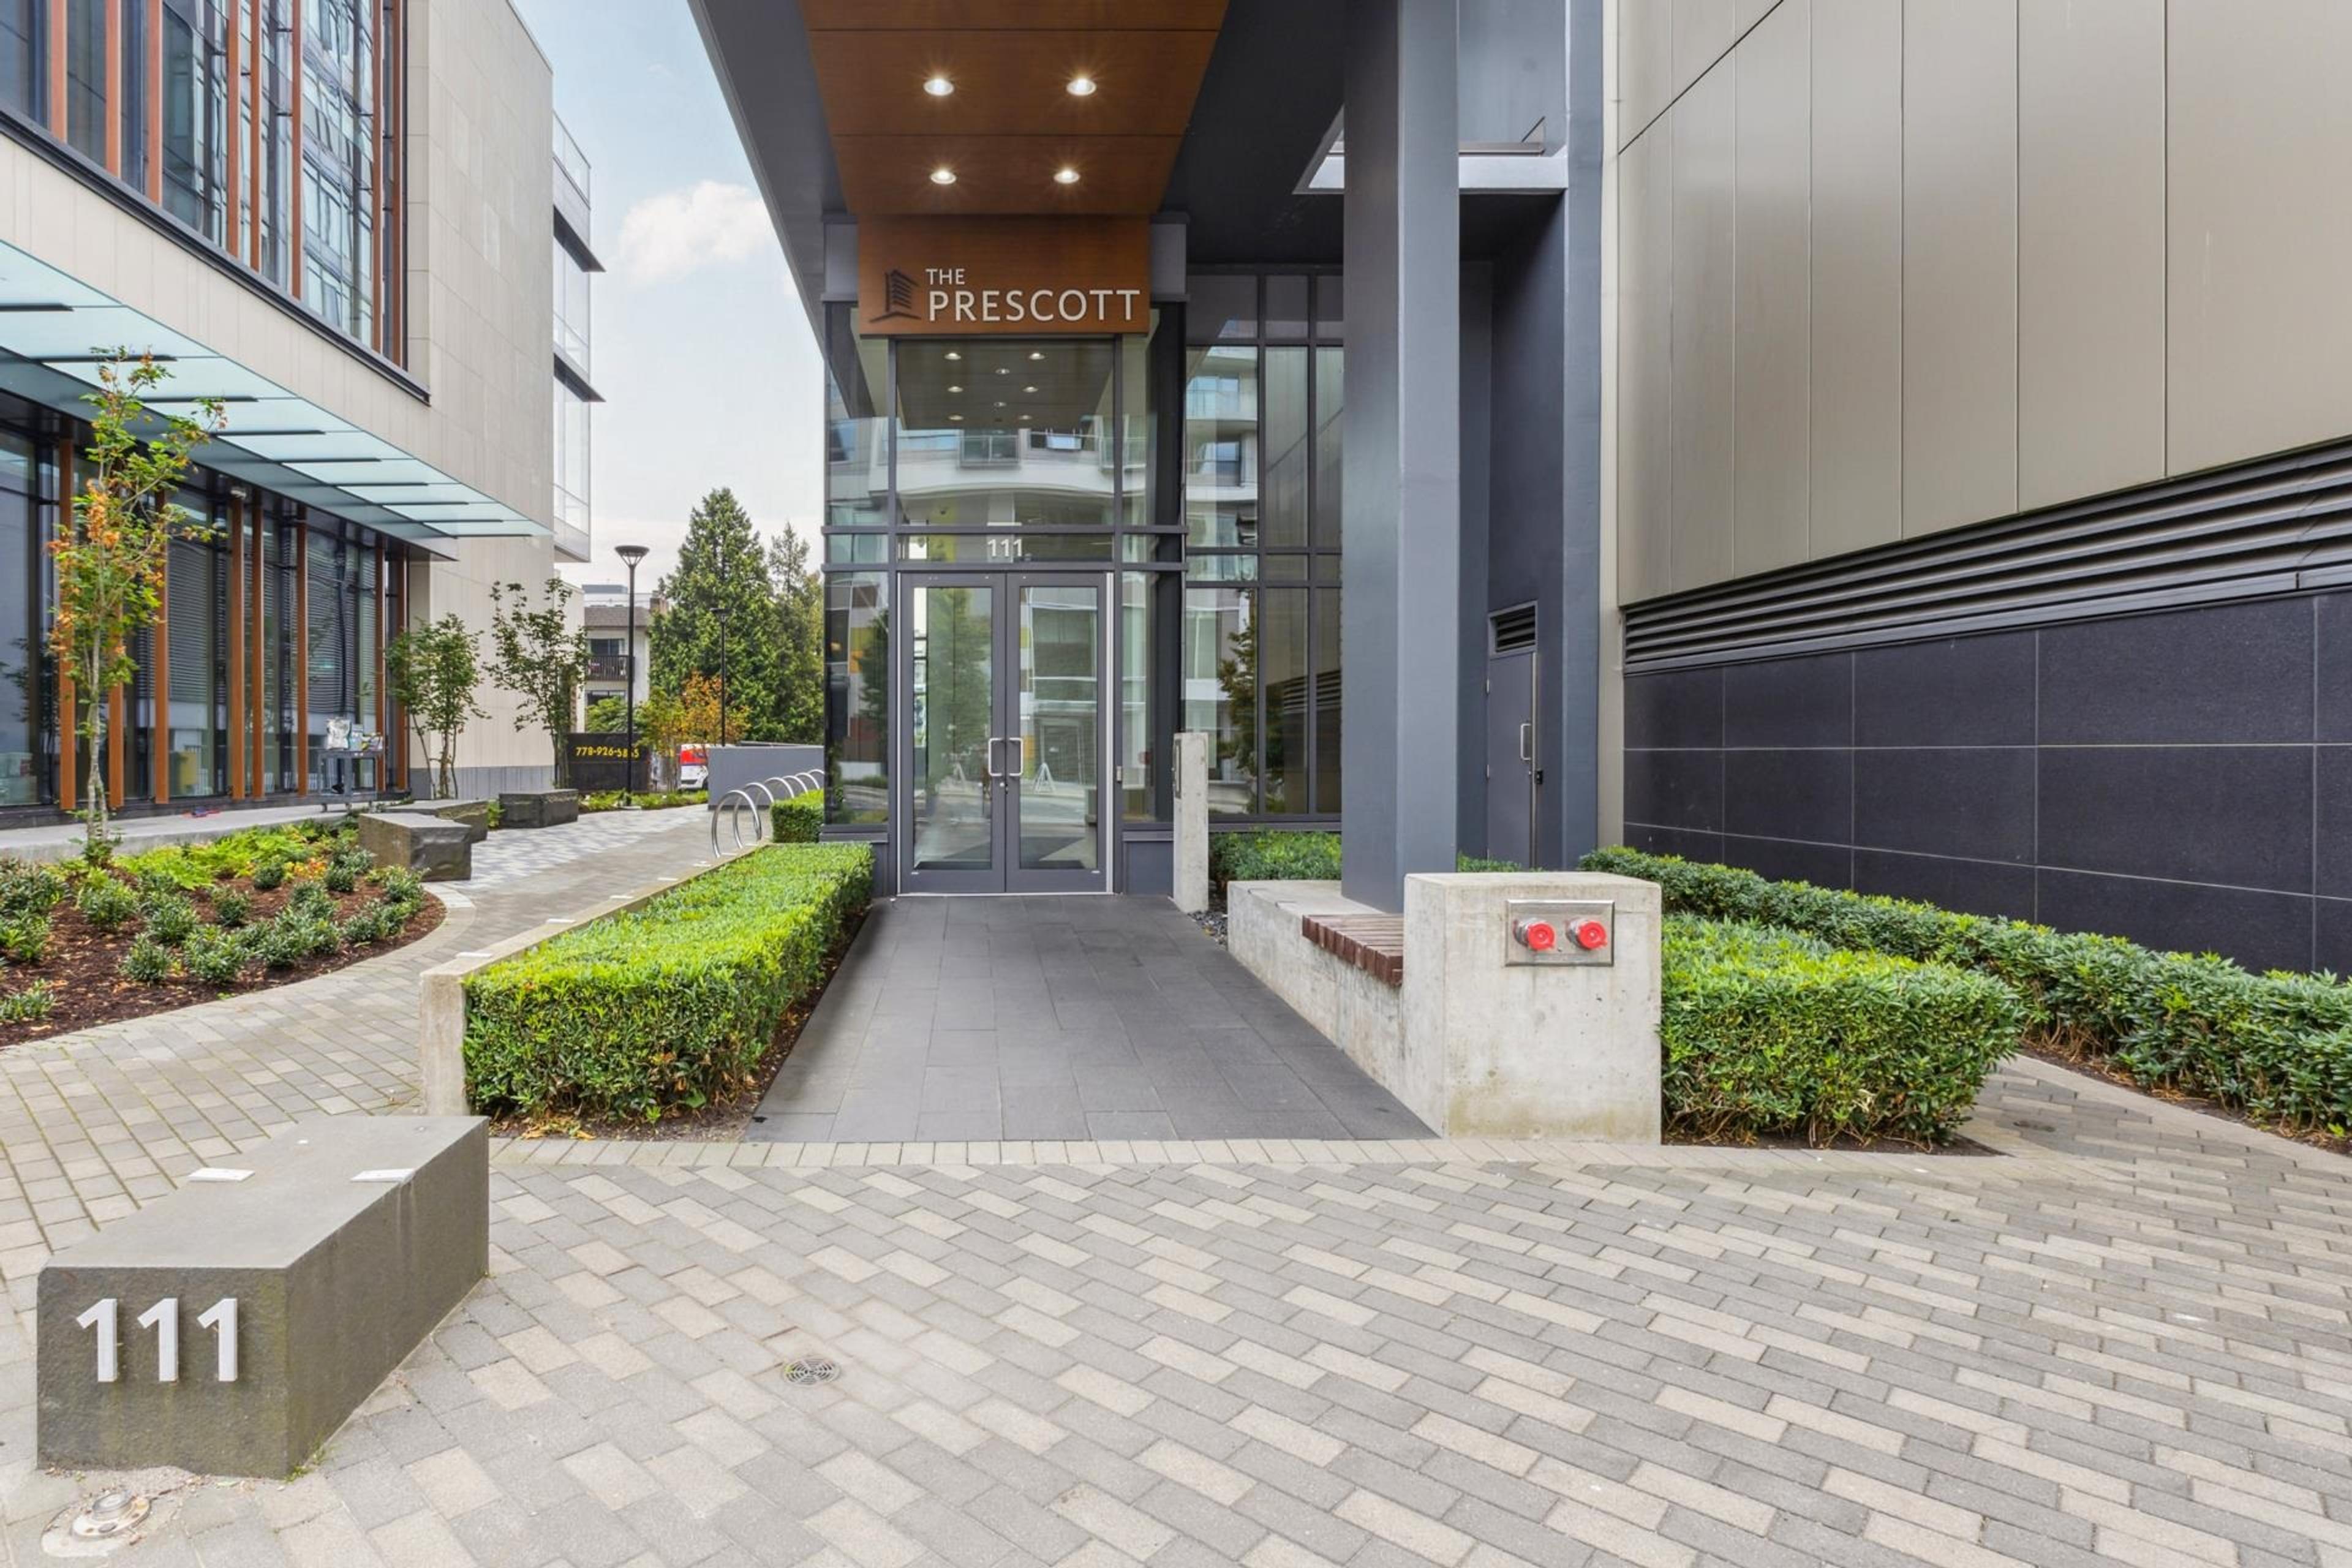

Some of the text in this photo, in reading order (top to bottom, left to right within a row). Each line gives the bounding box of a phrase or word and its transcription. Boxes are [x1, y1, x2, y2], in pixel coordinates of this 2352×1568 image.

[925, 269, 965, 285] THE
[929, 290, 1140, 322] PRESCOTT
[987, 539, 1022, 557] 111
[76, 1298, 238, 1382] 111
